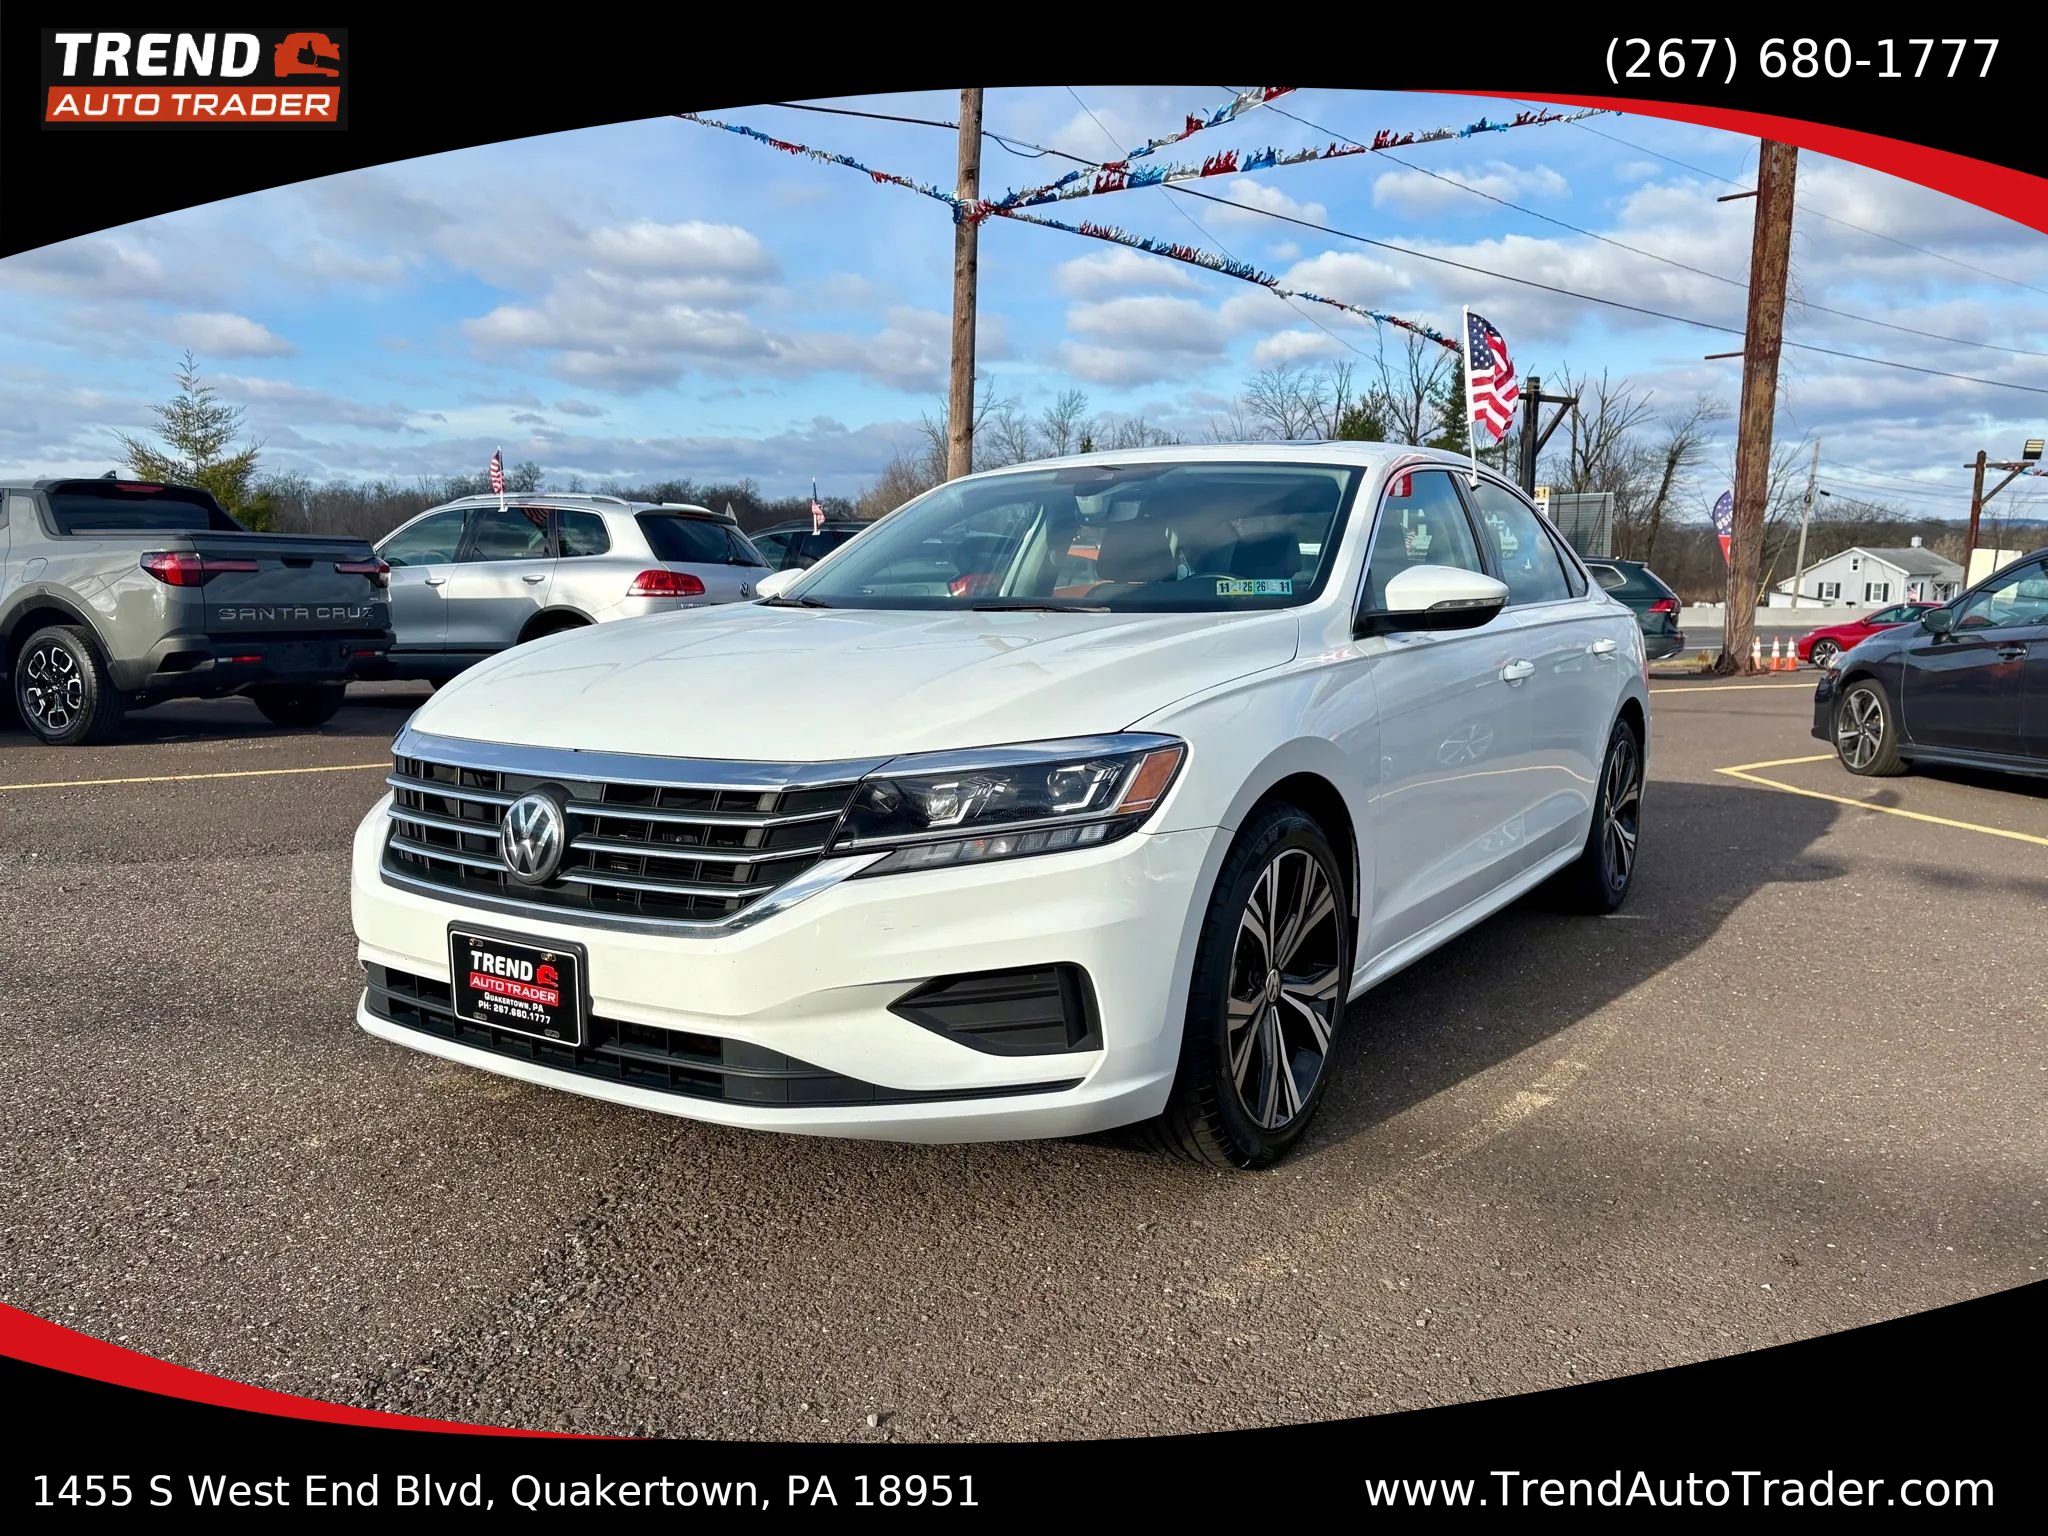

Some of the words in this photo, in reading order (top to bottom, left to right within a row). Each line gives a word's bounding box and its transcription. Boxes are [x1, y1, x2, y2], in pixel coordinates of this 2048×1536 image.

[1243, 581, 1252, 592] 26
[1256, 581, 1266, 592] 26
[218, 607, 309, 621] SANTA
[316, 607, 374, 620] CRUZ
[470, 951, 533, 981] TREND
[471, 975, 505, 992] AUTO
[506, 983, 556, 1003] TRADER
[478, 1000, 491, 1010] PH:
[493, 1004, 551, 1024] 267.680.1777
[532, 1003, 544, 1013] PA
